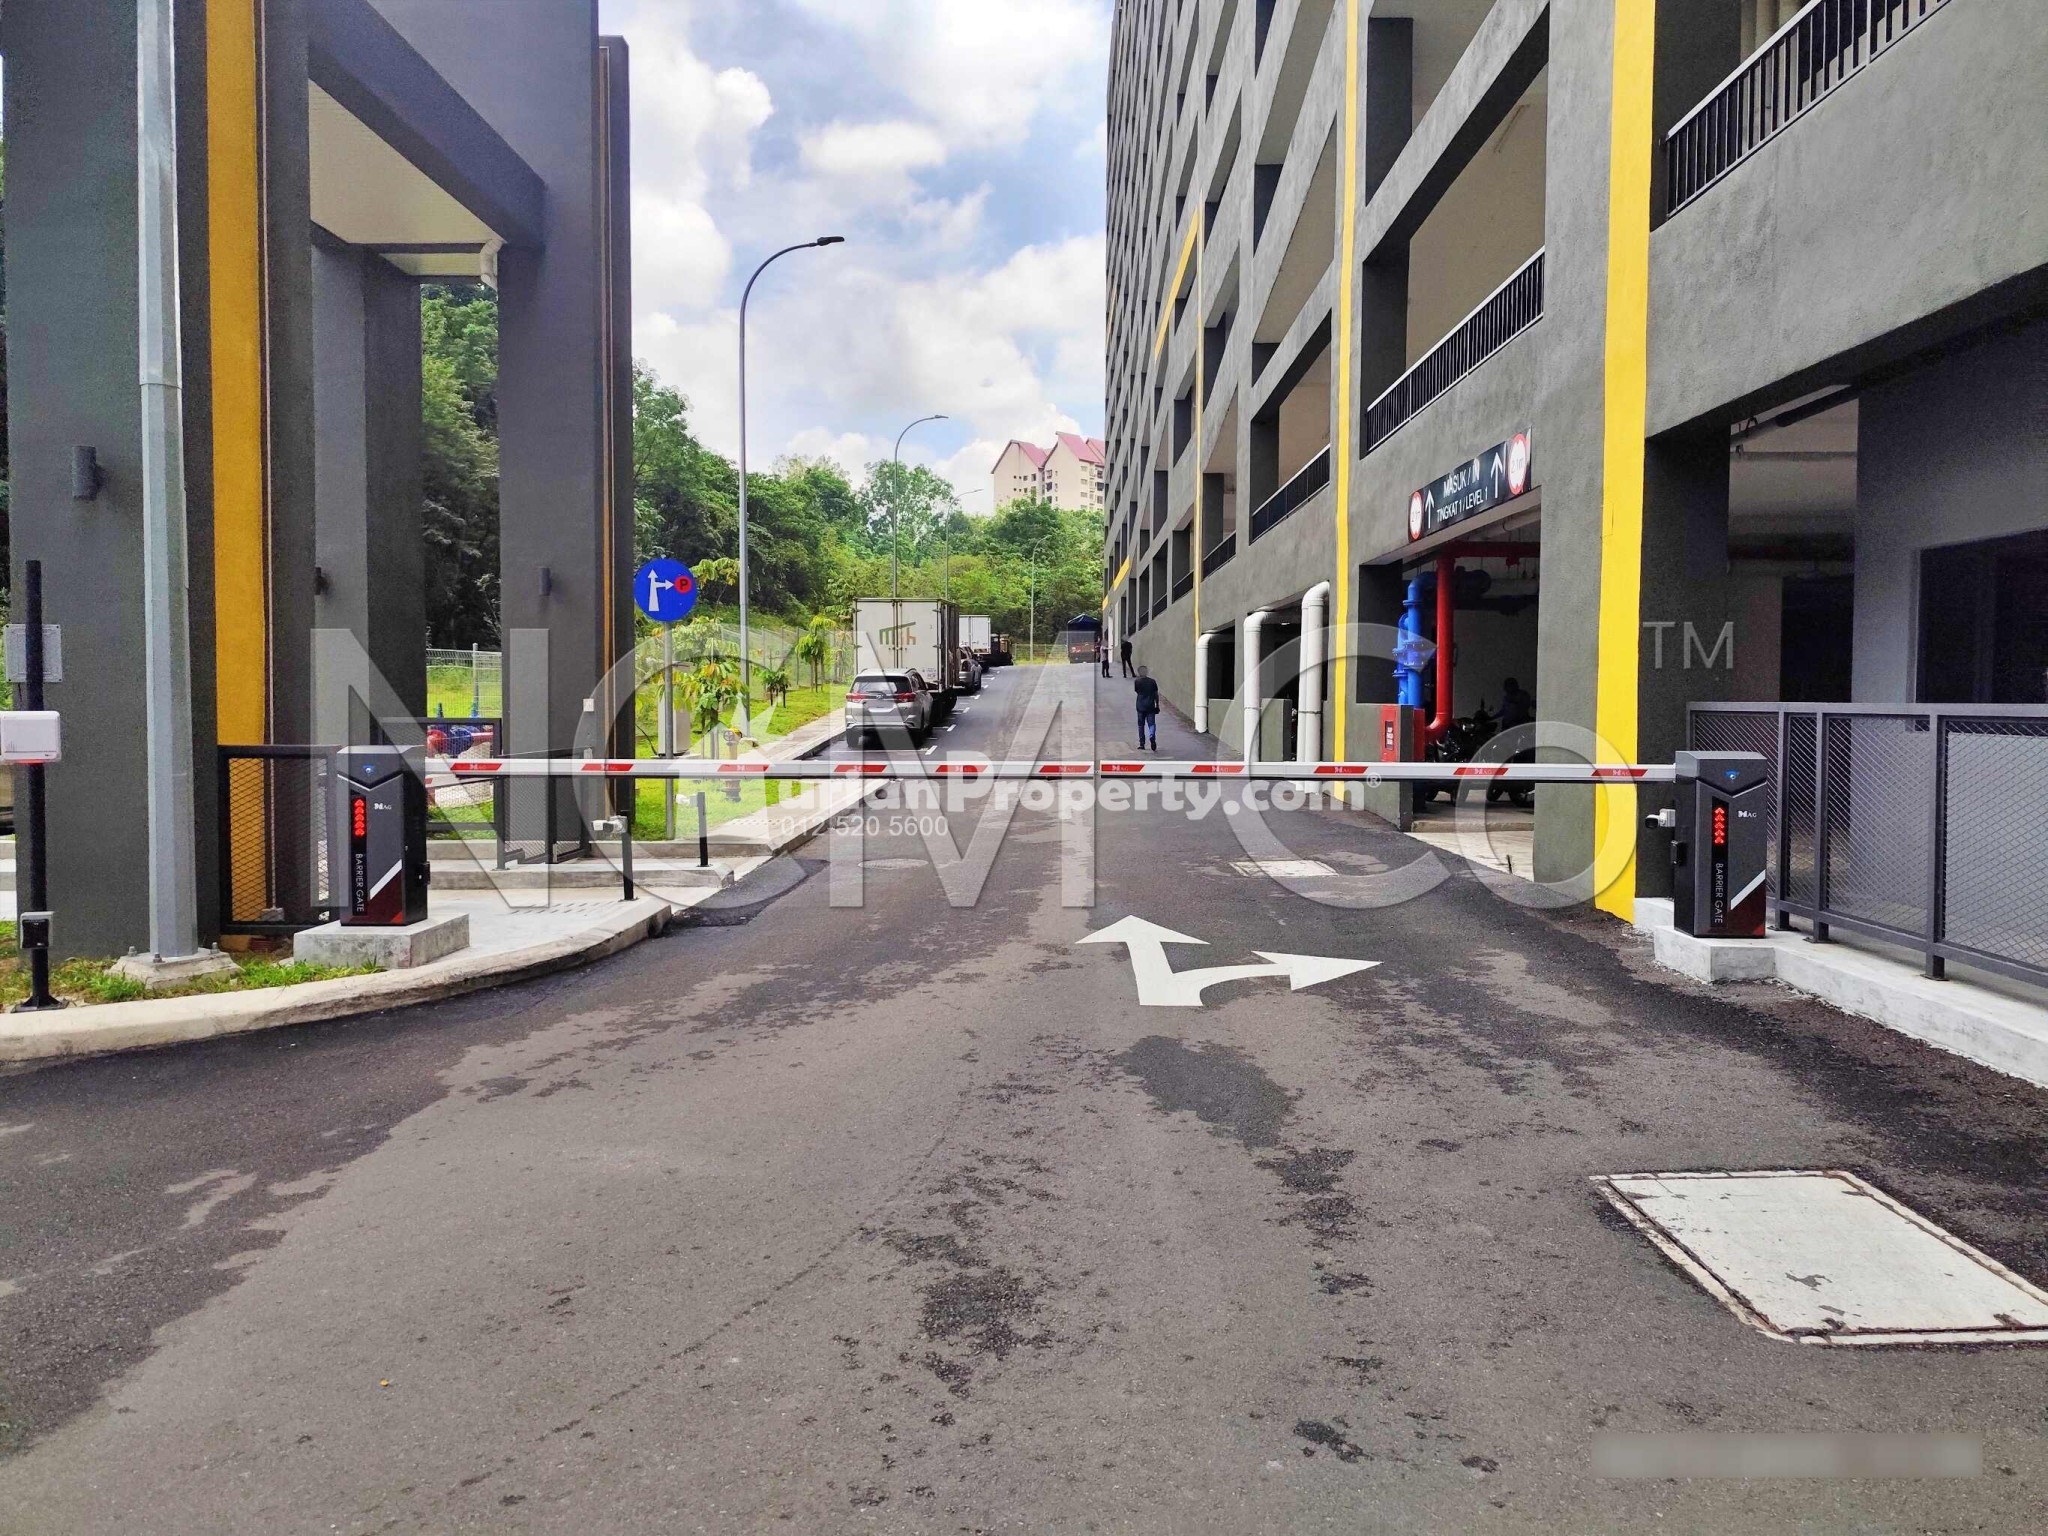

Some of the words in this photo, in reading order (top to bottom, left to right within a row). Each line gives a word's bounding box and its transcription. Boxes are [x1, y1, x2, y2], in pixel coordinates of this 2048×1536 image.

[1443, 469, 1467, 498] MASUK
[1472, 457, 1480, 483] IN
[1437, 500, 1459, 523] TINGKAT
[1465, 489, 1484, 510] LEVEL
[679, 578, 689, 591] P
[354, 853, 364, 889] BARRIER
[1714, 863, 1724, 898] BARRIER
[355, 890, 365, 912] GATE
[1714, 900, 1723, 924] GATE
